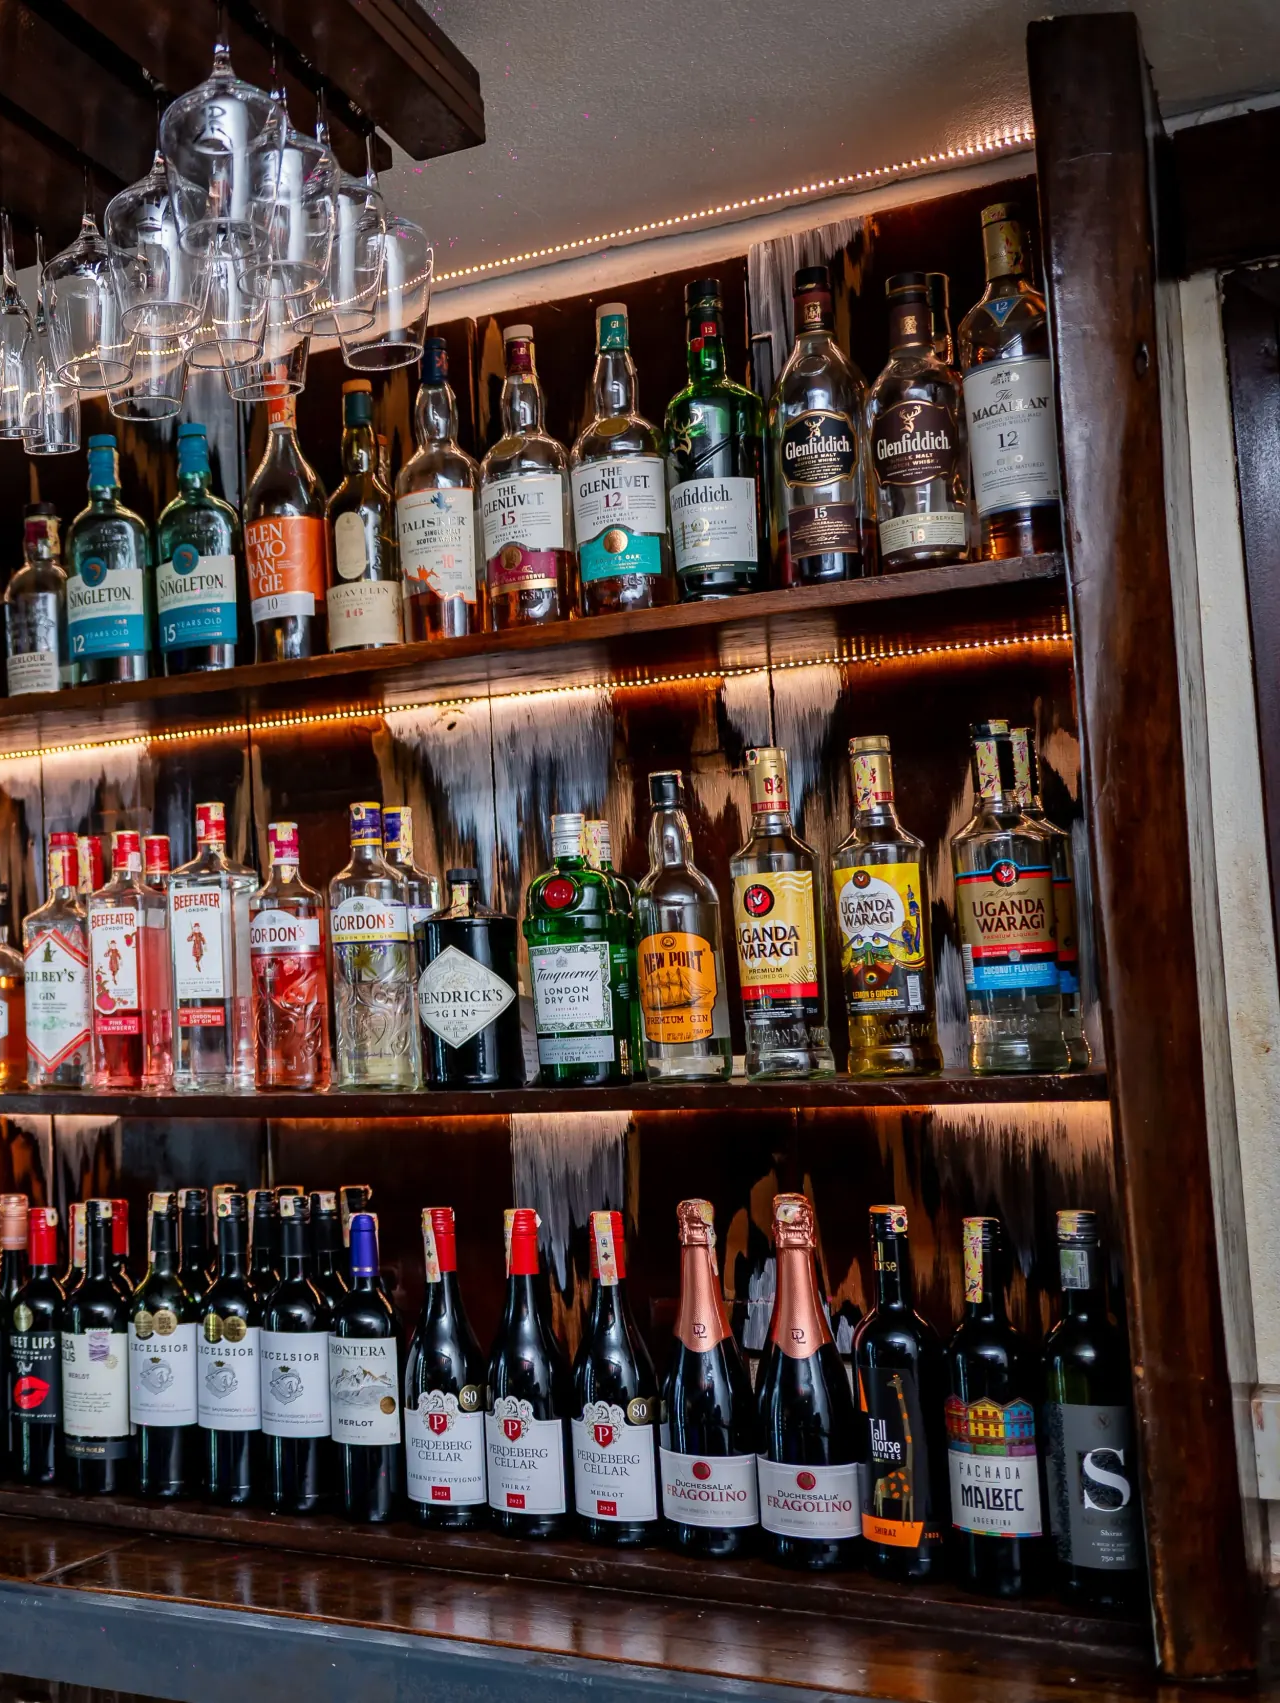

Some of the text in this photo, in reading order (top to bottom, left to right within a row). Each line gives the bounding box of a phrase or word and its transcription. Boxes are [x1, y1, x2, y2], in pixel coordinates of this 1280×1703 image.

[995, 301, 1009, 313] 12
[704, 324, 714, 334] 12
[995, 389, 1014, 403] The
[271, 411, 281, 422] 10
[972, 397, 1049, 423] MACALLAN
[1005, 415, 1025, 424] SINGLE
[1027, 412, 1042, 420] MALT
[986, 419, 1031, 432] SCOTCH WHISKY
[997, 430, 1020, 449] 12
[794, 457, 841, 468] SCOTCH WHISKY
[797, 452, 837, 463] SINGLE MALT
[912, 458, 940, 467] WHISKY
[915, 452, 934, 460] MALT
[600, 466, 623, 478] THE
[999, 466, 1014, 475] CASK
[1015, 462, 1046, 472] MATURED
[497, 484, 517, 498] THE
[604, 491, 622, 509] 12
[501, 510, 516, 527] 15
[597, 513, 617, 521] SINGLE
[813, 506, 828, 519] 15
[402, 515, 466, 535] TALISKER
[592, 518, 614, 527] SCOTCH
[247, 521, 284, 547] GLEN
[424, 528, 445, 538] SINGLE
[514, 528, 528, 536] MALT
[909, 529, 926, 542] 18
[416, 537, 437, 546] SCOTCH
[257, 539, 286, 560] MO
[441, 553, 456, 569] 10
[625, 553, 641, 561] OAK
[250, 557, 277, 580] RAN
[160, 573, 224, 599] SINGLETON
[259, 573, 284, 594] GIE
[70, 586, 131, 610] SINGLETON
[331, 586, 389, 602] AGAVULIN
[267, 596, 278, 611] 10
[177, 617, 223, 631] YEARS OLD
[86, 627, 129, 640] YEARS OLD
[164, 623, 177, 643] 15
[72, 634, 85, 654] 12
[173, 891, 221, 911] BEEFEATER
[840, 899, 895, 916] UGANDA
[971, 898, 1046, 918] UGANDA
[91, 912, 136, 931] BEEFEATER
[333, 911, 397, 932] GORDON'S
[843, 911, 894, 929] WARAGI
[976, 914, 1045, 934] WARAGI
[250, 925, 306, 945] GORDON'S
[737, 925, 800, 945] UGANDA
[1013, 931, 1040, 939] LIQUEUR
[738, 941, 799, 961] WARAGI
[643, 950, 704, 980] NEW PORT
[748, 967, 784, 975] PREMIUM
[983, 962, 1048, 976] COCONUT FLAVOURED
[24, 969, 76, 983] GILBEY'S
[536, 968, 599, 983] Tanqueray
[745, 972, 791, 981] FLAVOURED GIN
[38, 991, 56, 1001] GIN
[419, 988, 504, 1005] HENDRICK'S
[544, 985, 589, 996] LONDON
[853, 990, 871, 1000] LEMON
[877, 987, 899, 998] GINGER
[544, 994, 590, 1005] DRY GIN
[440, 1007, 470, 1019] GIN
[646, 1013, 709, 1025] PREMIUM GIN
[97, 1024, 137, 1033] STRAWBERRY
[692, 1029, 704, 1037] 750
[31, 1335, 57, 1350] LIPS
[462, 1390, 478, 1404] 80
[631, 1403, 647, 1417] 80
[338, 1418, 375, 1428] MERLOT
[432, 1415, 445, 1431] P
[507, 1421, 519, 1437] P
[868, 1417, 888, 1443] Tall
[596, 1426, 609, 1442] P
[410, 1436, 473, 1452] PERDEBERG
[488, 1443, 550, 1459] PERDEBERG
[417, 1450, 464, 1463] CELLAR
[576, 1448, 641, 1465] PERDEBERG
[872, 1453, 902, 1461] WINES
[494, 1457, 539, 1471] CELLAR
[583, 1462, 631, 1477] CELLAR
[958, 1461, 1021, 1480] FACHADA
[439, 1475, 482, 1484] SAUVIGNON
[1082, 1446, 1132, 1512] S
[500, 1482, 532, 1491] SHIRAZ
[666, 1484, 748, 1502] FRAGOLINO
[590, 1489, 625, 1499] MERLOT
[960, 1483, 1025, 1512] MALBEC
[599, 1504, 615, 1513] 2024
[766, 1495, 853, 1513] FRAGOLINO
[972, 1515, 1012, 1527] ARGENTINA
[874, 1525, 897, 1538] SHIRAZ
[1099, 1528, 1123, 1538] Shiraz
[1100, 1552, 1126, 1562] 750 ml
